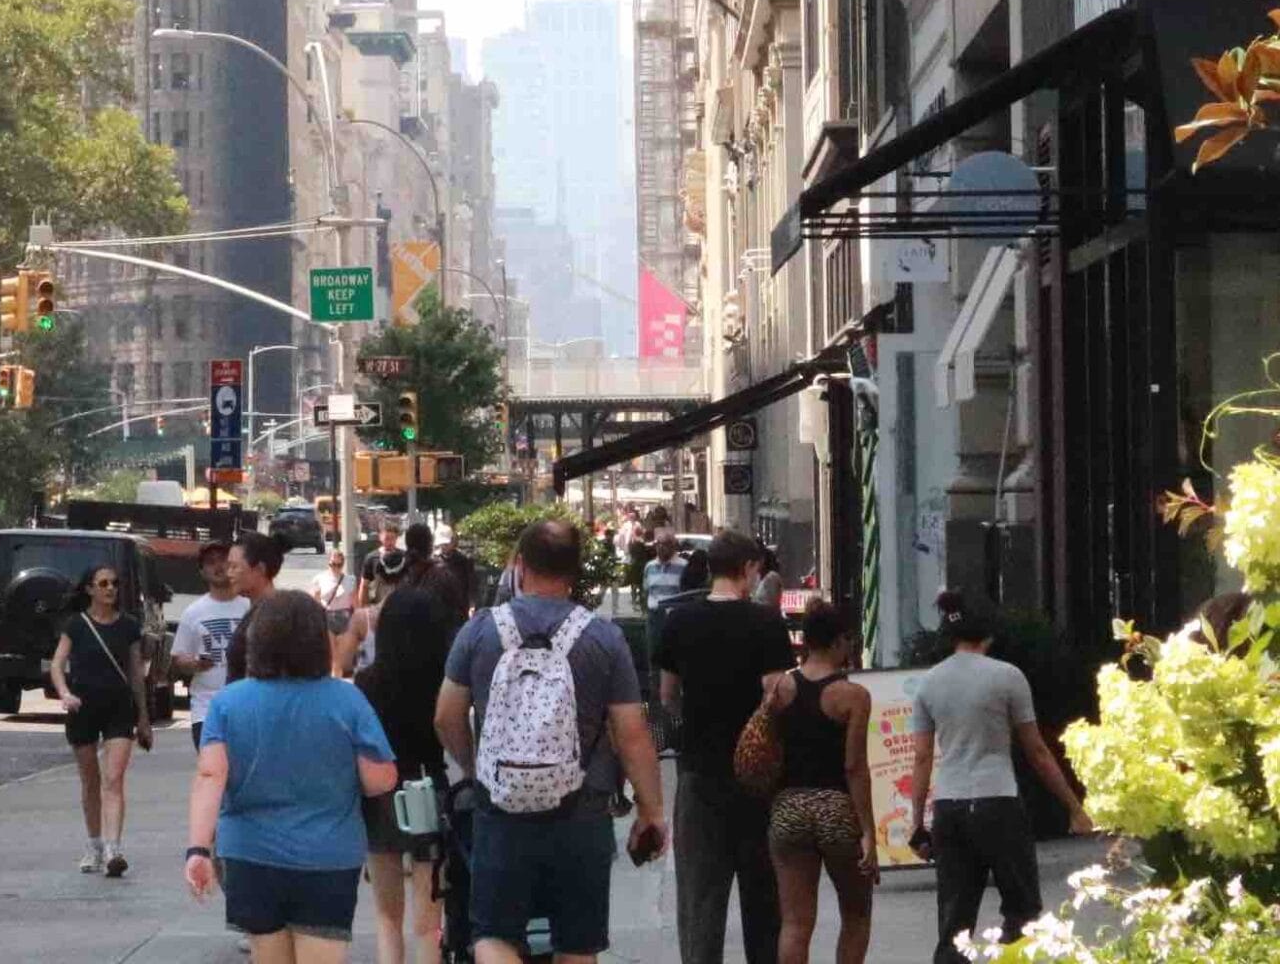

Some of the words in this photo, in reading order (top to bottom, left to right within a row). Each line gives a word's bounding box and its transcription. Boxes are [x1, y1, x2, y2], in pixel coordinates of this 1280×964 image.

[313, 274, 369, 287] BROADWAY
[328, 288, 356, 301] KEEP
[329, 302, 355, 315] LEFT
